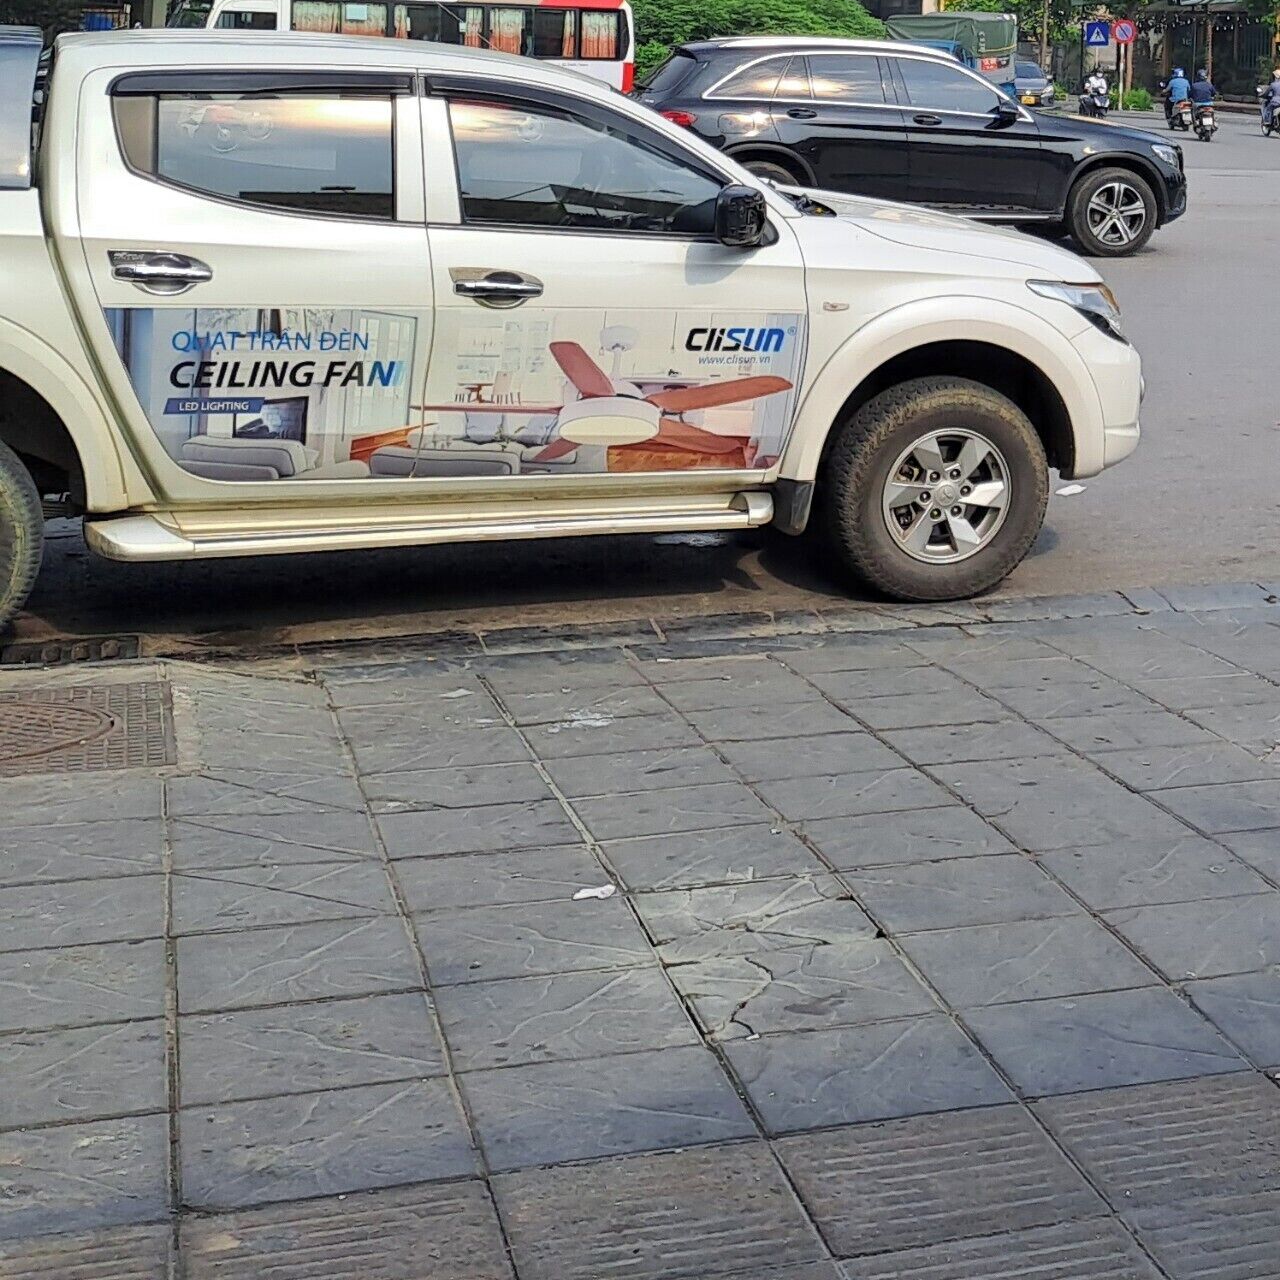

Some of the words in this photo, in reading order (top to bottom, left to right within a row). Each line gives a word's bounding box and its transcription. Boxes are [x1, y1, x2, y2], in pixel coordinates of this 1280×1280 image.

[318, 327, 369, 351] ĐÈN
[698, 354, 771, 365] www.clisun.vn
[169, 361, 315, 388] CEILING
[322, 361, 397, 388] FAN
[179, 401, 199, 412] LED
[200, 401, 250, 412] LIGHTING
